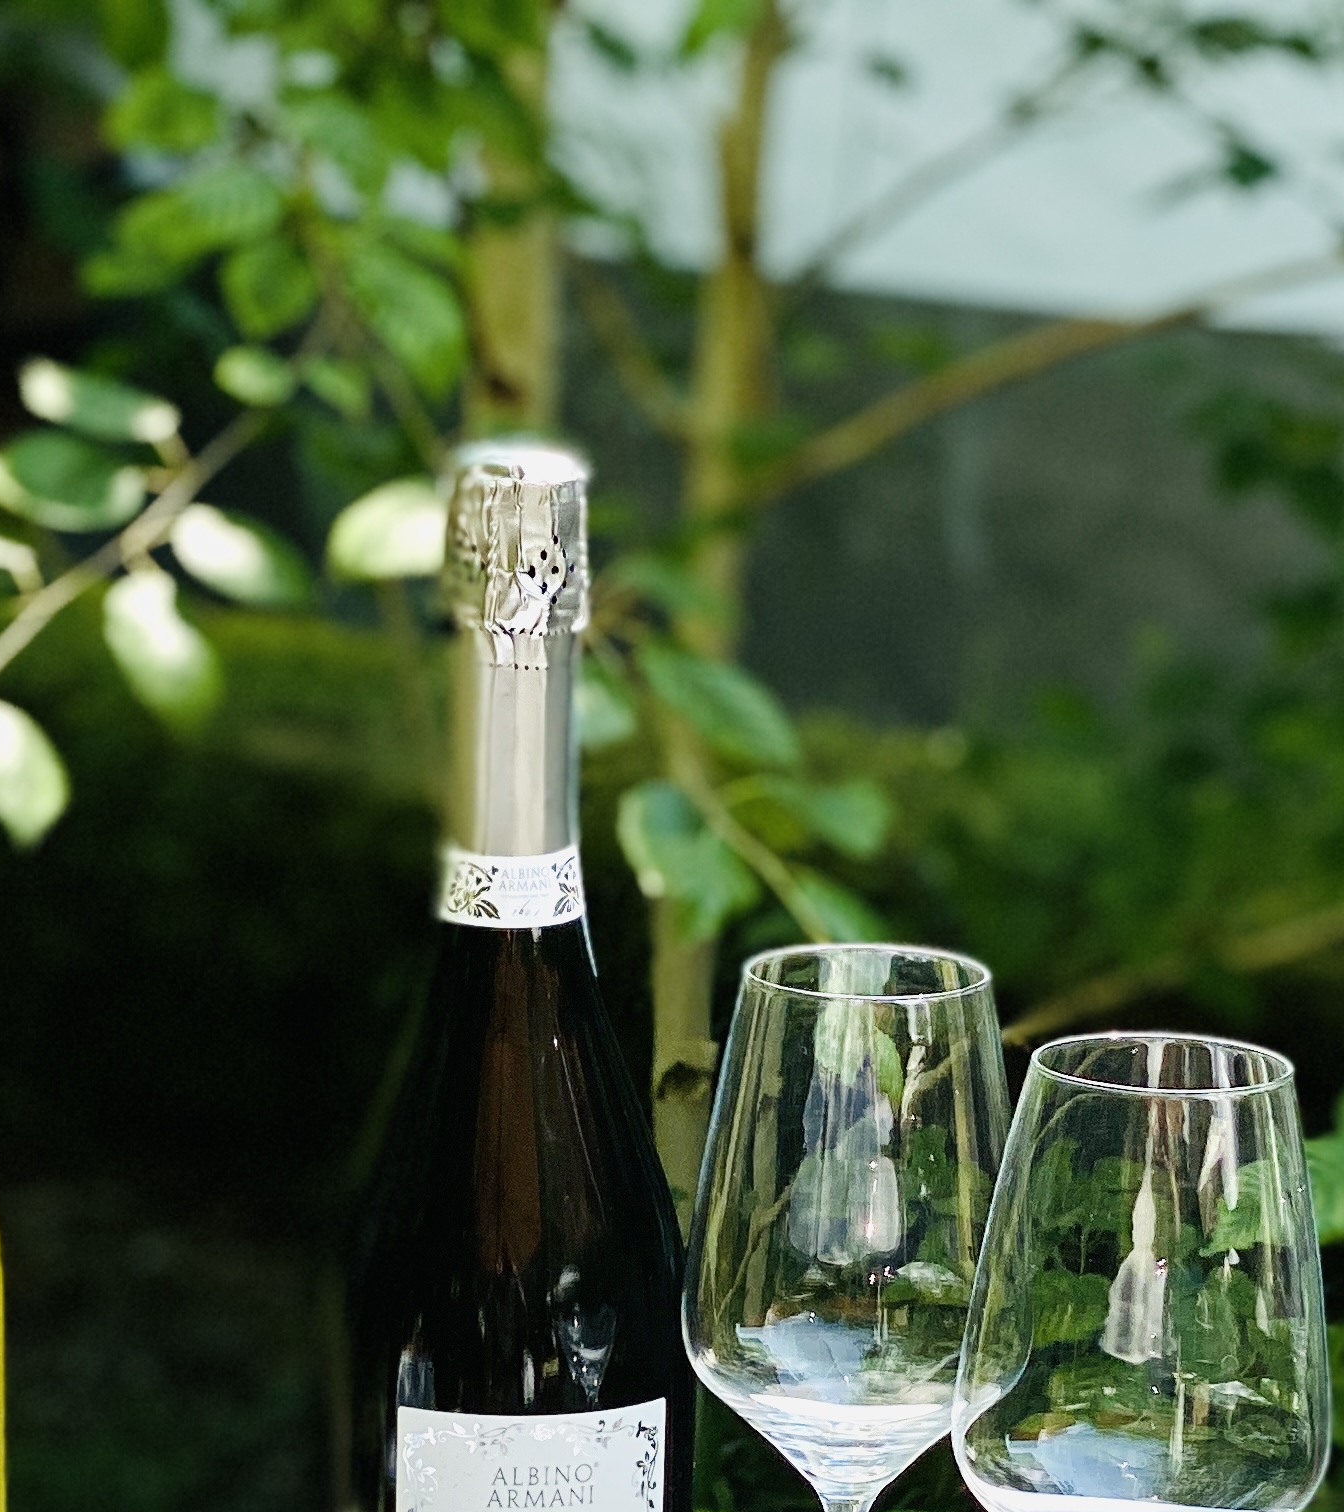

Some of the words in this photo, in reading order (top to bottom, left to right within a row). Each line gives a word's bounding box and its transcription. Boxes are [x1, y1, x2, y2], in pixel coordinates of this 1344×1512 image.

[501, 867, 550, 880] ALBINO
[498, 879, 552, 892] ARMANI
[491, 1463, 593, 1486] ALBINO
[486, 1485, 594, 1508] ARMANI
